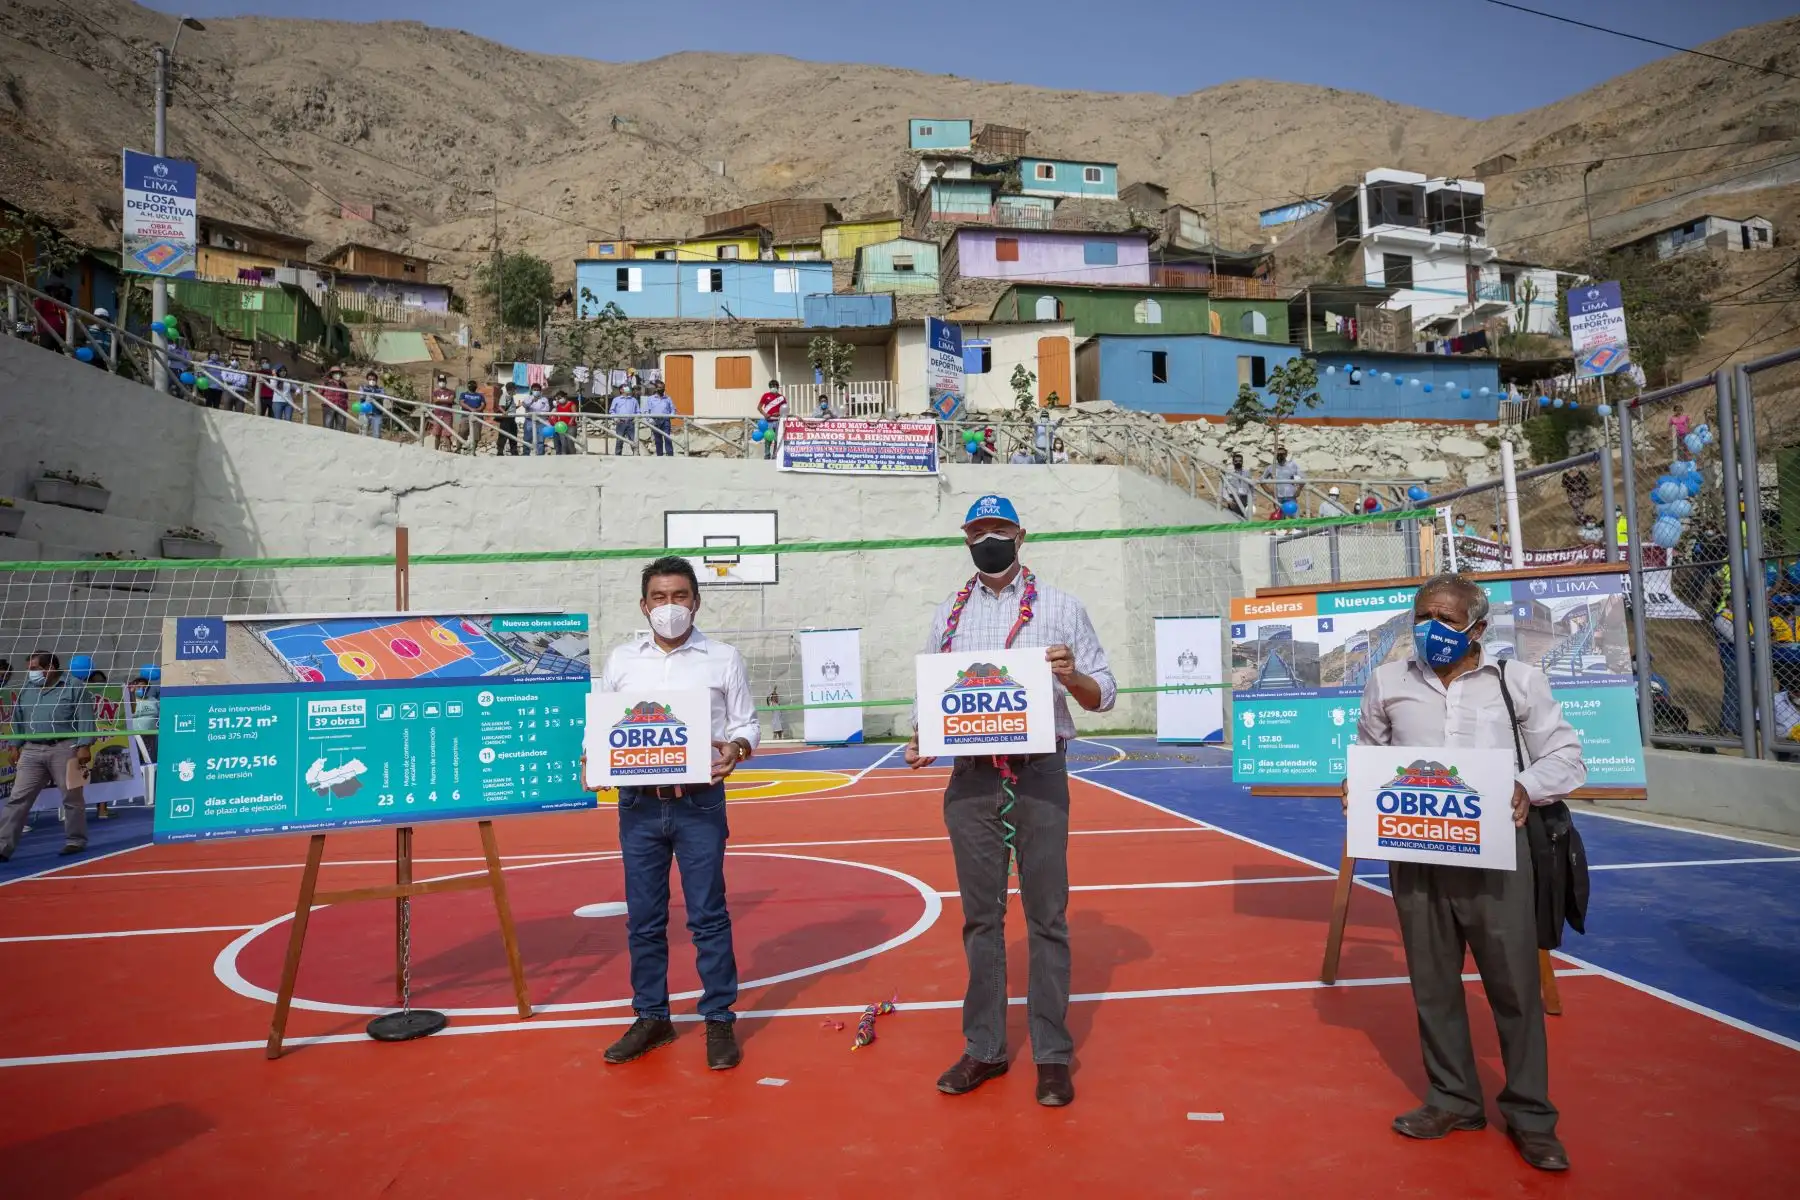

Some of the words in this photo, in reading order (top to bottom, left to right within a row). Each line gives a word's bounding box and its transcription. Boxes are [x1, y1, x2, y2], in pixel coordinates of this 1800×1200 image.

[143, 179, 178, 193] LIMA
[145, 193, 176, 206] LOSA
[127, 199, 194, 217] DEPORTIVA
[137, 228, 184, 236] ENTREGADA
[1581, 301, 1608, 312] LIMA
[1584, 312, 1608, 322] LOSA
[1572, 316, 1623, 331] DEPORTIVA
[938, 341, 955, 352] LIMA
[939, 353, 955, 363] LOSA
[931, 358, 963, 373] DEPORTIVA
[848, 422, 868, 430] MAYO
[807, 432, 846, 441] DAMOS
[848, 433, 860, 441] LA
[976, 507, 1000, 517] LIMA
[1535, 549, 1589, 562] DISTRITAL
[1556, 580, 1599, 593] LIMA
[1334, 596, 1385, 608] Nuevas
[1244, 601, 1303, 615] Escaleras
[1518, 607, 1526, 617] 8
[1322, 621, 1329, 630] 4
[183, 645, 219, 654] LIMA
[1431, 655, 1450, 663] LIMA
[1165, 682, 1212, 695] LIMA
[496, 693, 538, 702] terminadas
[810, 688, 853, 702] LIMA
[208, 704, 227, 713] Área
[228, 703, 272, 712] intervenida
[941, 691, 1028, 715] OBRAS
[1560, 700, 1601, 709] /514,249
[311, 703, 337, 714] Lima
[340, 703, 363, 713] Este
[517, 708, 526, 716] 11
[1258, 710, 1298, 718] S/298,002
[208, 716, 252, 729] 511.72
[256, 715, 278, 727] m²
[314, 717, 328, 726] 39
[330, 715, 361, 726] obras
[569, 718, 574, 726] 3
[946, 715, 1025, 734] Sociales
[207, 733, 227, 741] (losa
[228, 732, 242, 740] 375
[243, 731, 258, 740] m2)
[518, 734, 523, 742] 1
[608, 726, 688, 748] OBRAS
[953, 735, 999, 743] MUNICIPALIDAD
[1000, 734, 1009, 742] DE
[1009, 734, 1025, 742] LIMA
[1258, 735, 1282, 743] 157.80
[452, 737, 460, 766] deportivas
[498, 750, 548, 759] ejecutándose
[206, 755, 278, 770] S/179,516
[430, 758, 436, 766] de
[613, 749, 685, 766] Sociales
[402, 760, 409, 768] de
[519, 764, 525, 772] 3
[546, 762, 551, 770] 1
[1242, 762, 1252, 770] 30
[1258, 759, 1274, 767] días
[1276, 759, 1317, 767] calendario
[619, 767, 661, 775] MUNICIPALIDAD
[670, 766, 685, 774] LIMA
[1266, 767, 1281, 775] plazo
[1290, 766, 1317, 775] ejecución
[1601, 765, 1635, 773] ejecución
[206, 772, 214, 780] de
[216, 771, 253, 779] inversión
[547, 775, 552, 783] 2
[572, 773, 577, 781] 2
[405, 792, 415, 804] 6
[428, 791, 437, 802] 4
[452, 789, 460, 800] 6
[521, 790, 526, 798] 1
[204, 796, 227, 807] días
[228, 793, 283, 806] calendario
[377, 794, 394, 806] 23
[1376, 790, 1482, 820] OBRAS
[175, 804, 190, 813] 40
[204, 807, 215, 816] de
[216, 806, 238, 817] plazo
[239, 804, 249, 813] de
[251, 803, 287, 814] ejecución
[1381, 816, 1478, 842] Sociales
[1390, 840, 1445, 851] MUNICIPALIDAD
[1446, 844, 1457, 852] DE
[1458, 845, 1477, 853] LIMA
